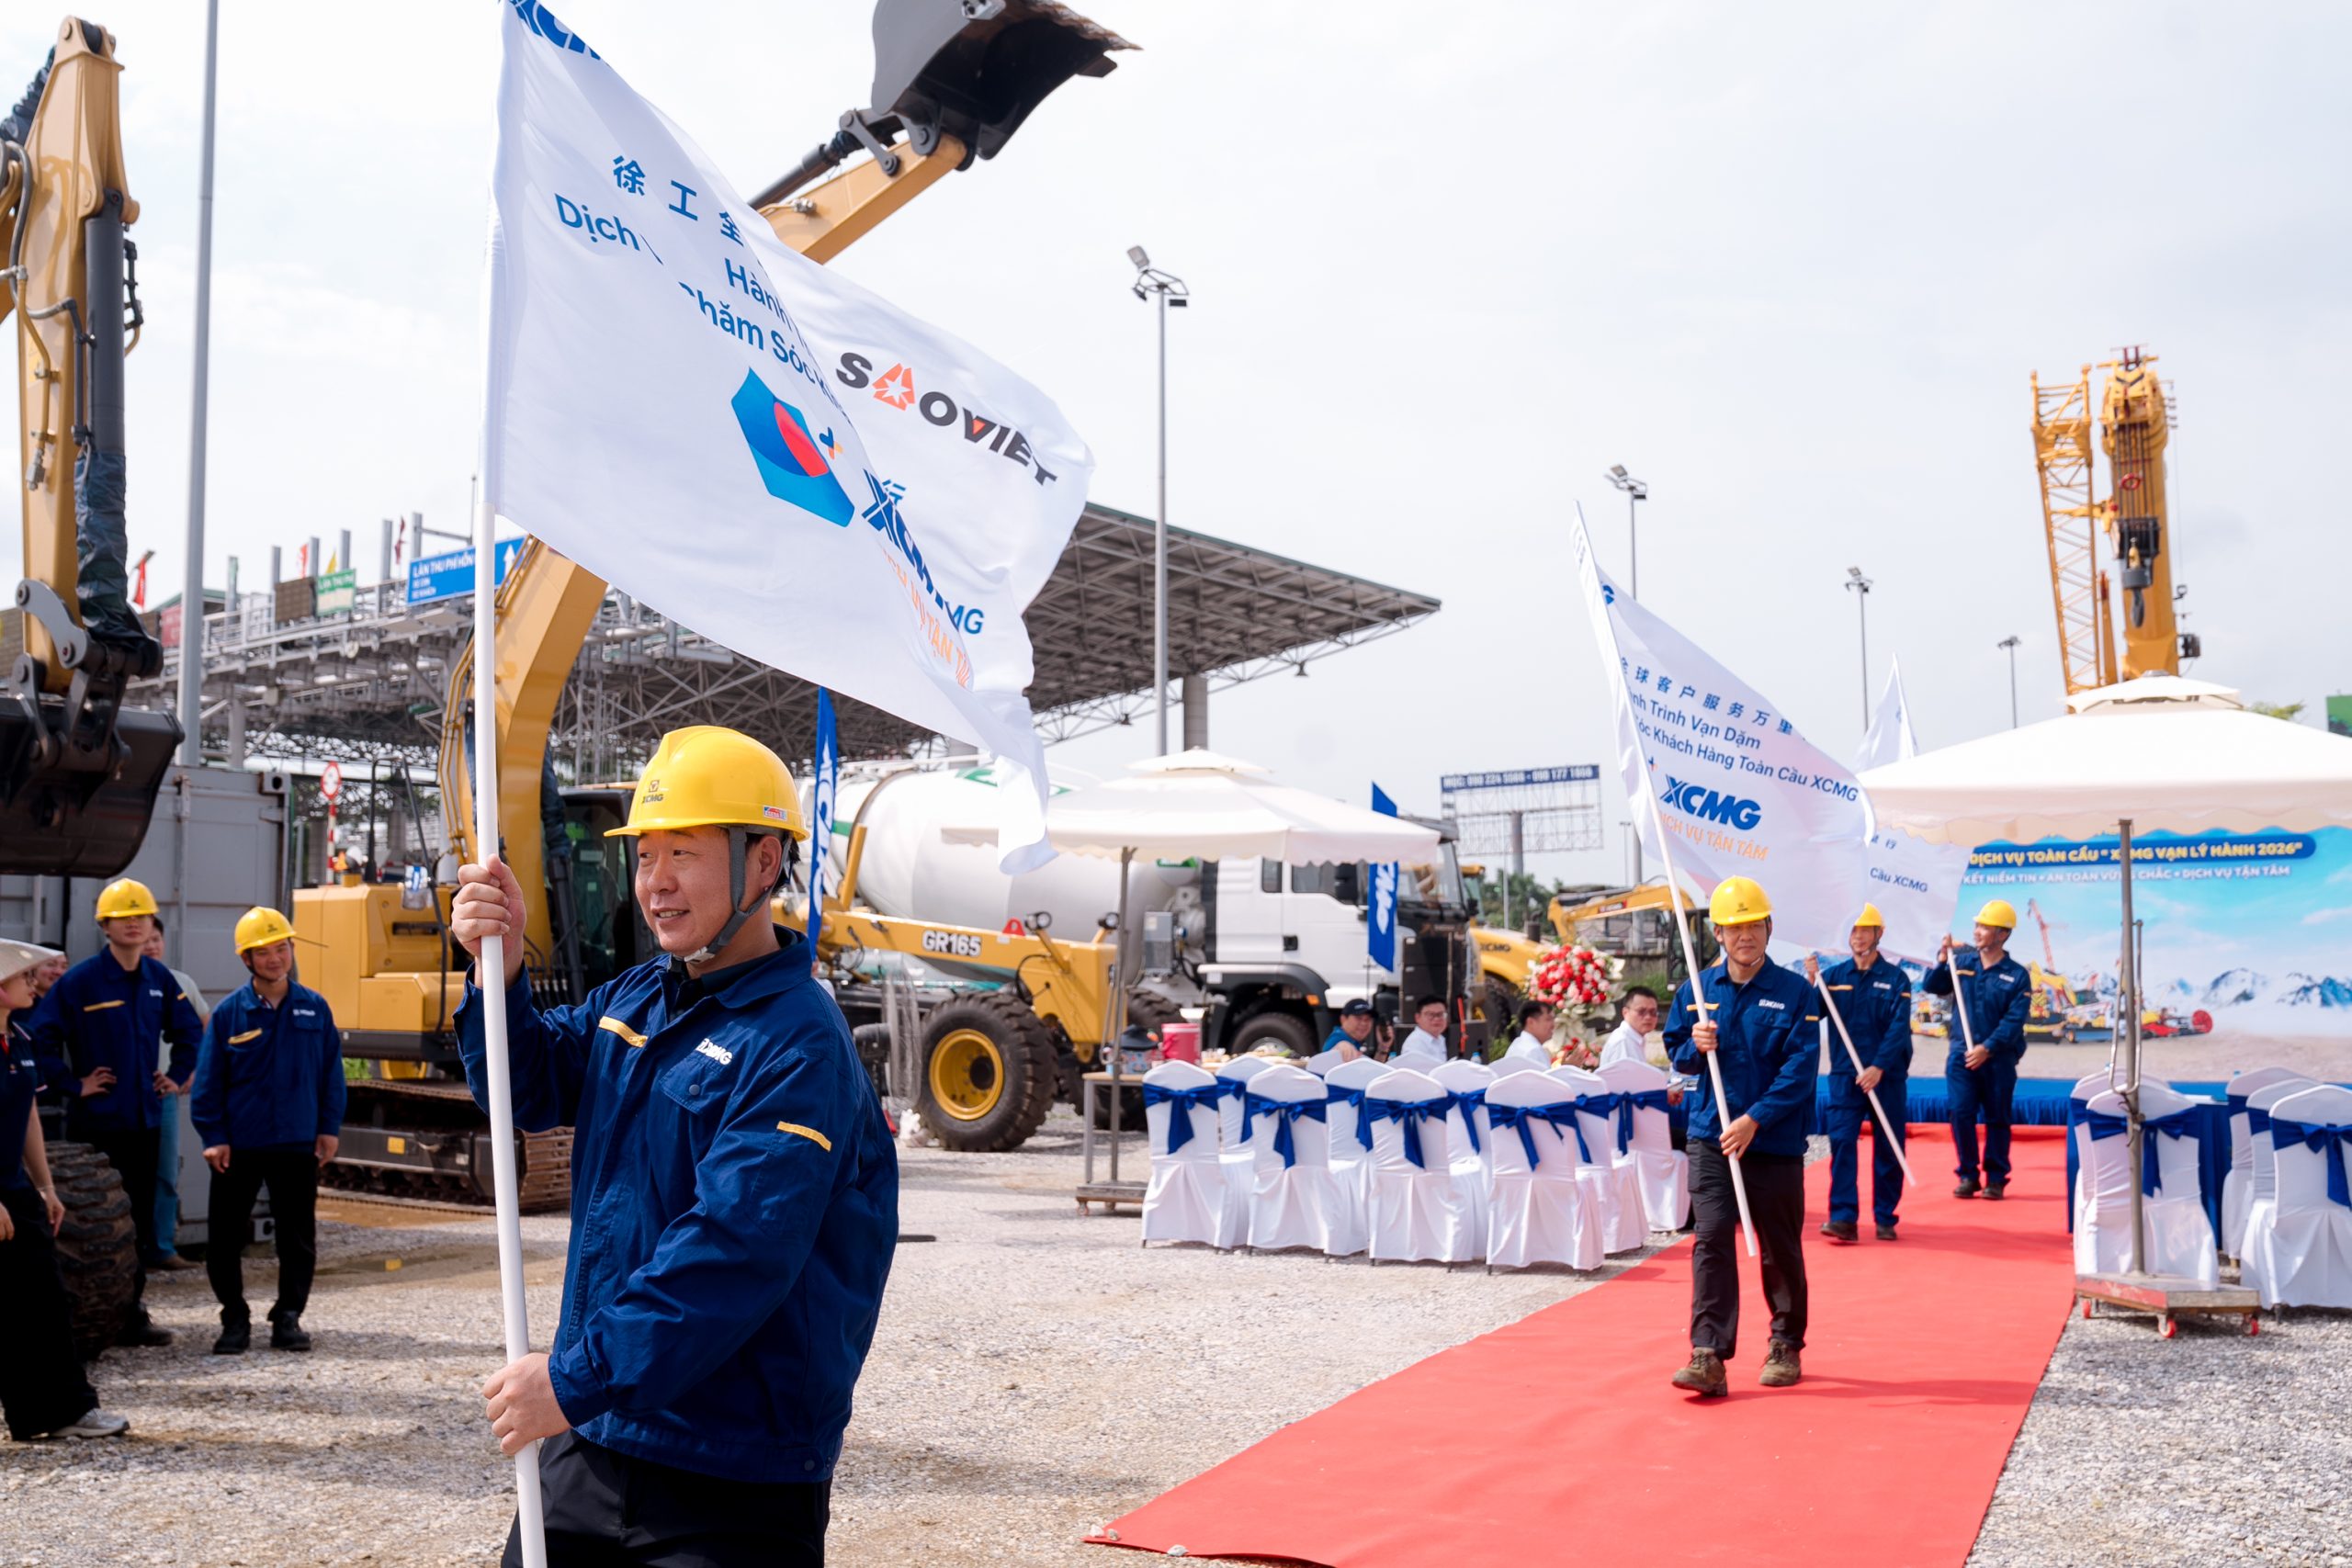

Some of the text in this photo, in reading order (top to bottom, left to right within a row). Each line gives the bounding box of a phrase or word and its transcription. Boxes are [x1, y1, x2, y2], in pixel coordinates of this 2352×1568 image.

[554, 193, 640, 252] Dịch
[1691, 716, 1719, 738] Vạn
[1654, 727, 1692, 755] Khách
[1810, 775, 1859, 801] XCMG
[1659, 774, 1761, 830] XCMG
[2005, 852, 2025, 866] VỤ
[2111, 847, 2154, 861] XMG
[922, 930, 982, 957] GR165
